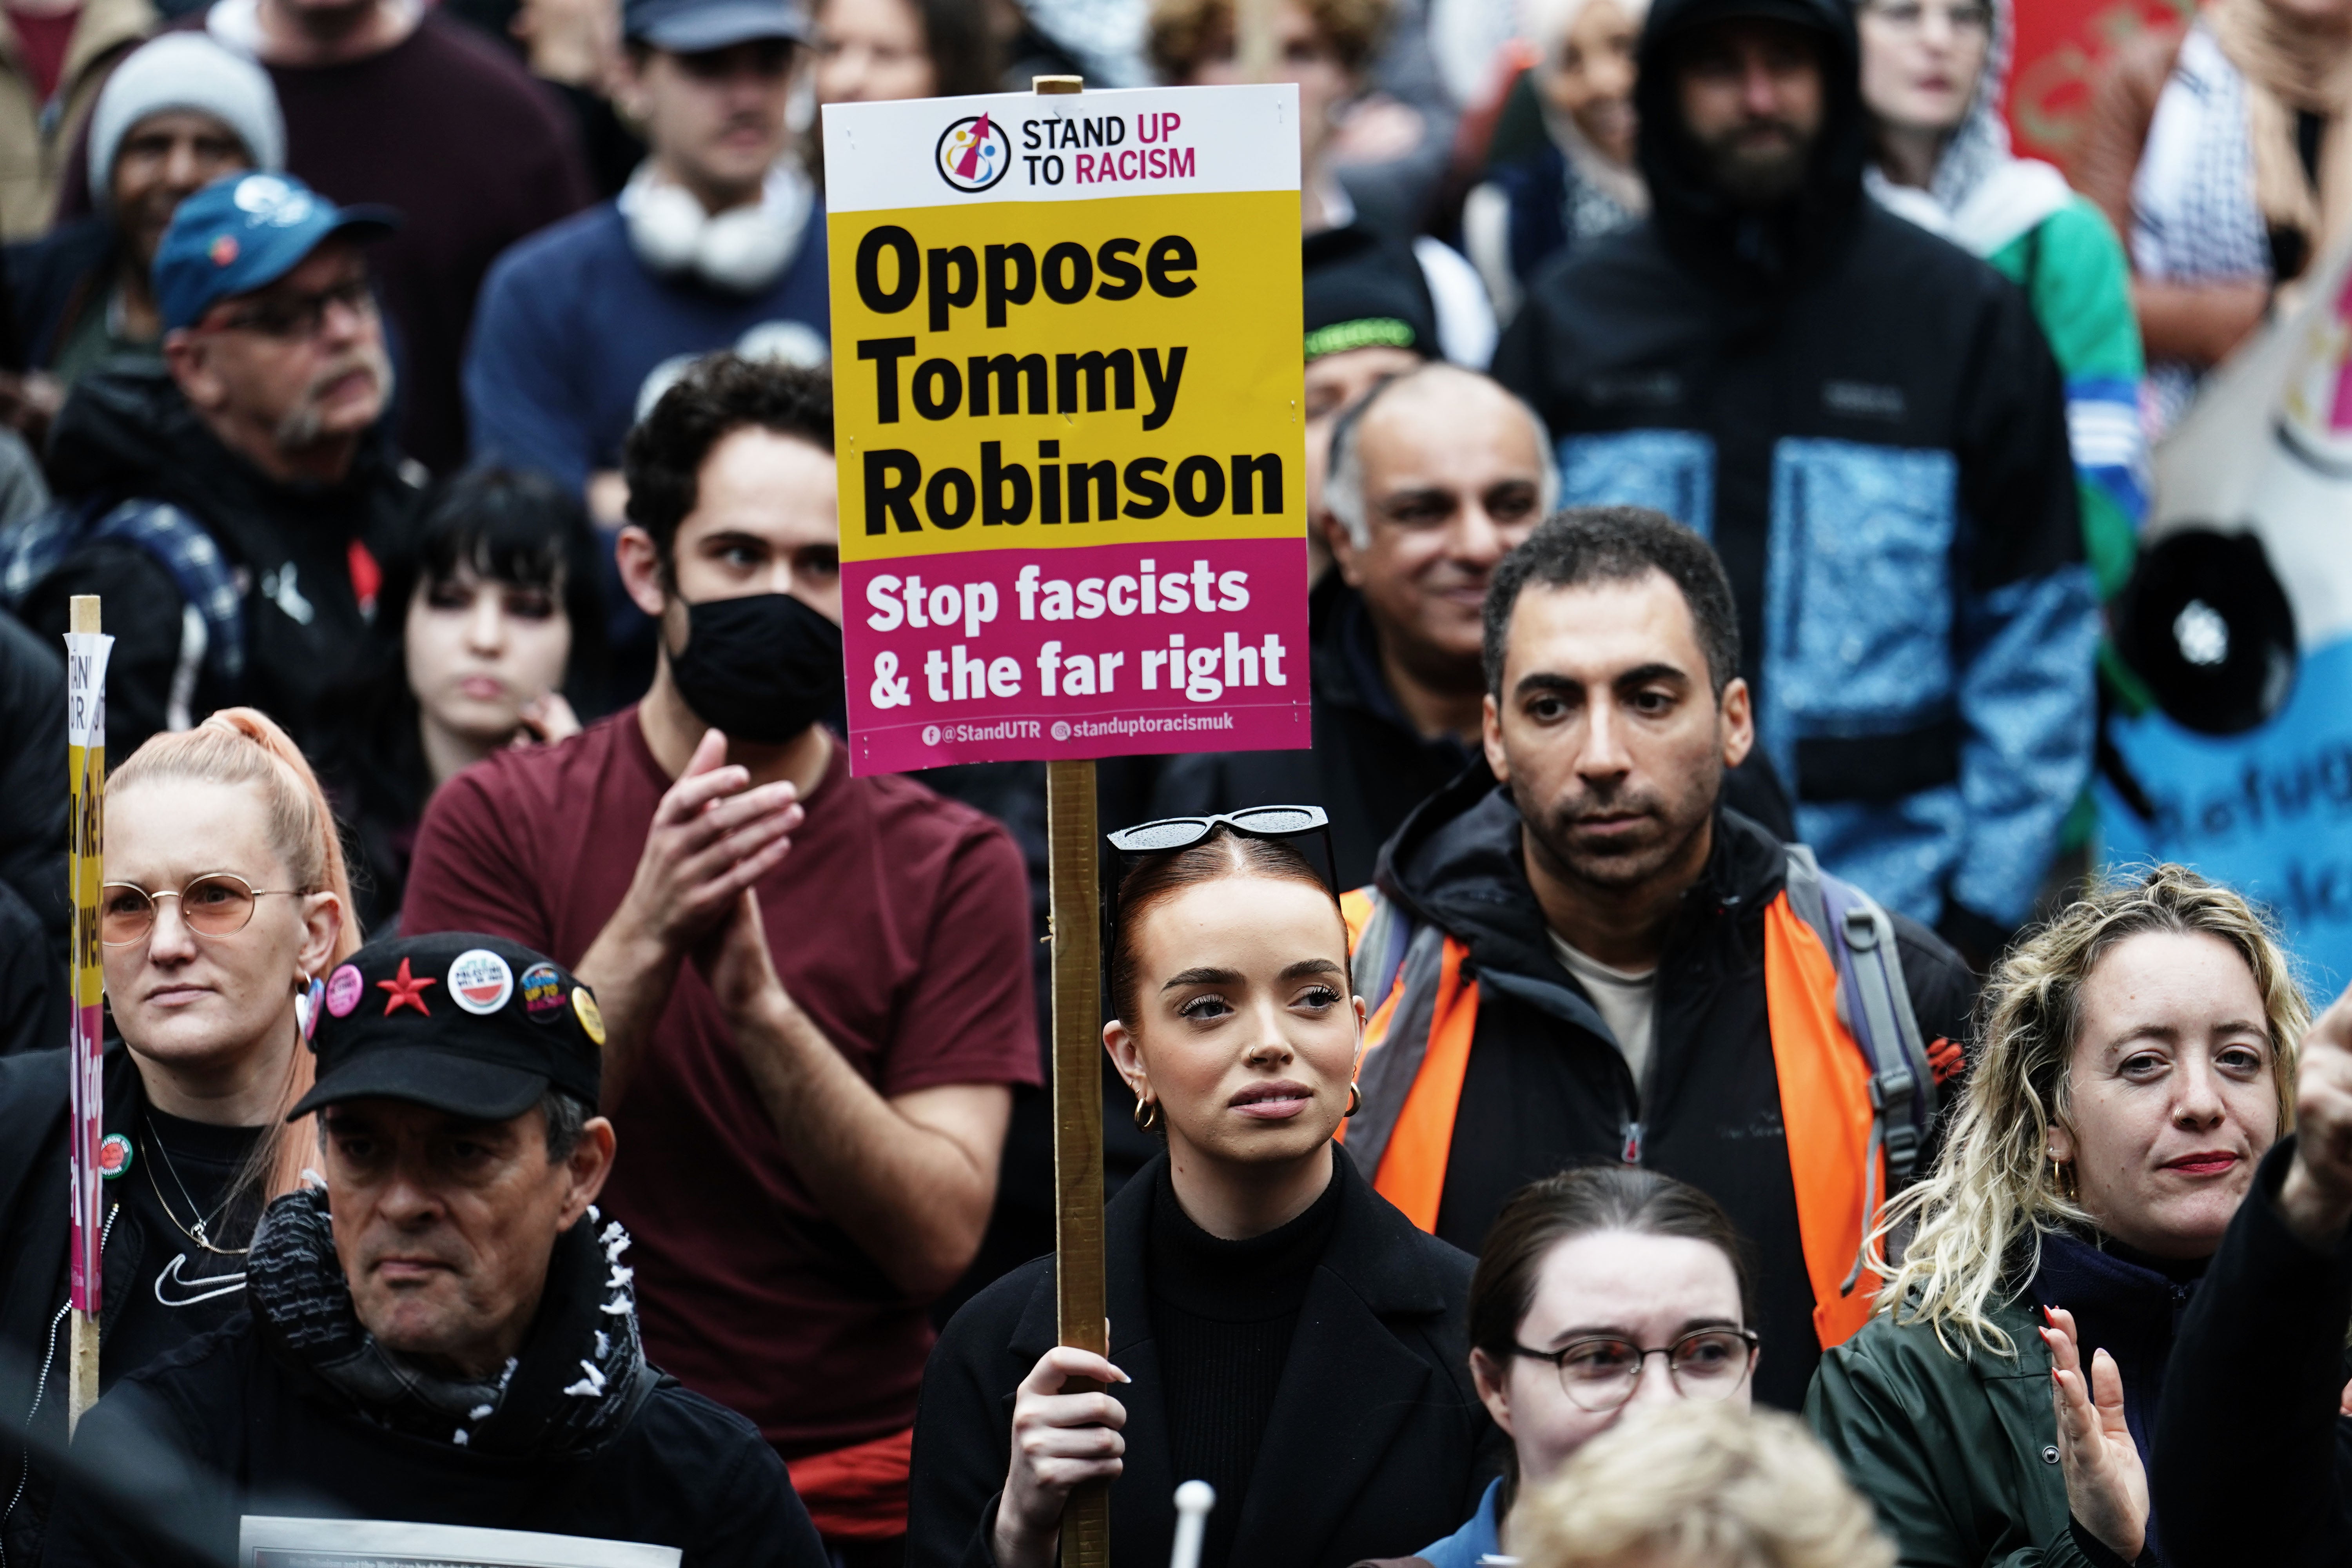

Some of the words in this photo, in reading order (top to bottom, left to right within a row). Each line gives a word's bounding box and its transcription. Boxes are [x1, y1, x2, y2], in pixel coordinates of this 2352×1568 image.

[1022, 117, 1125, 150] STAND
[1137, 113, 1181, 144] UP
[1022, 155, 1064, 186] TO
[1076, 147, 1196, 185] RACISM
[855, 225, 1198, 332] Oppose
[857, 336, 1188, 432] Tommy
[863, 439, 1284, 537] Robinson
[866, 573, 998, 638] Stop
[1015, 559, 1250, 621] fascists
[869, 650, 911, 710] &
[924, 644, 1022, 702] the
[1036, 640, 1124, 697] far
[1140, 632, 1287, 702] right
[941, 721, 1041, 743] @StandUTR
[1073, 713, 1234, 739] standuptoracismuk
